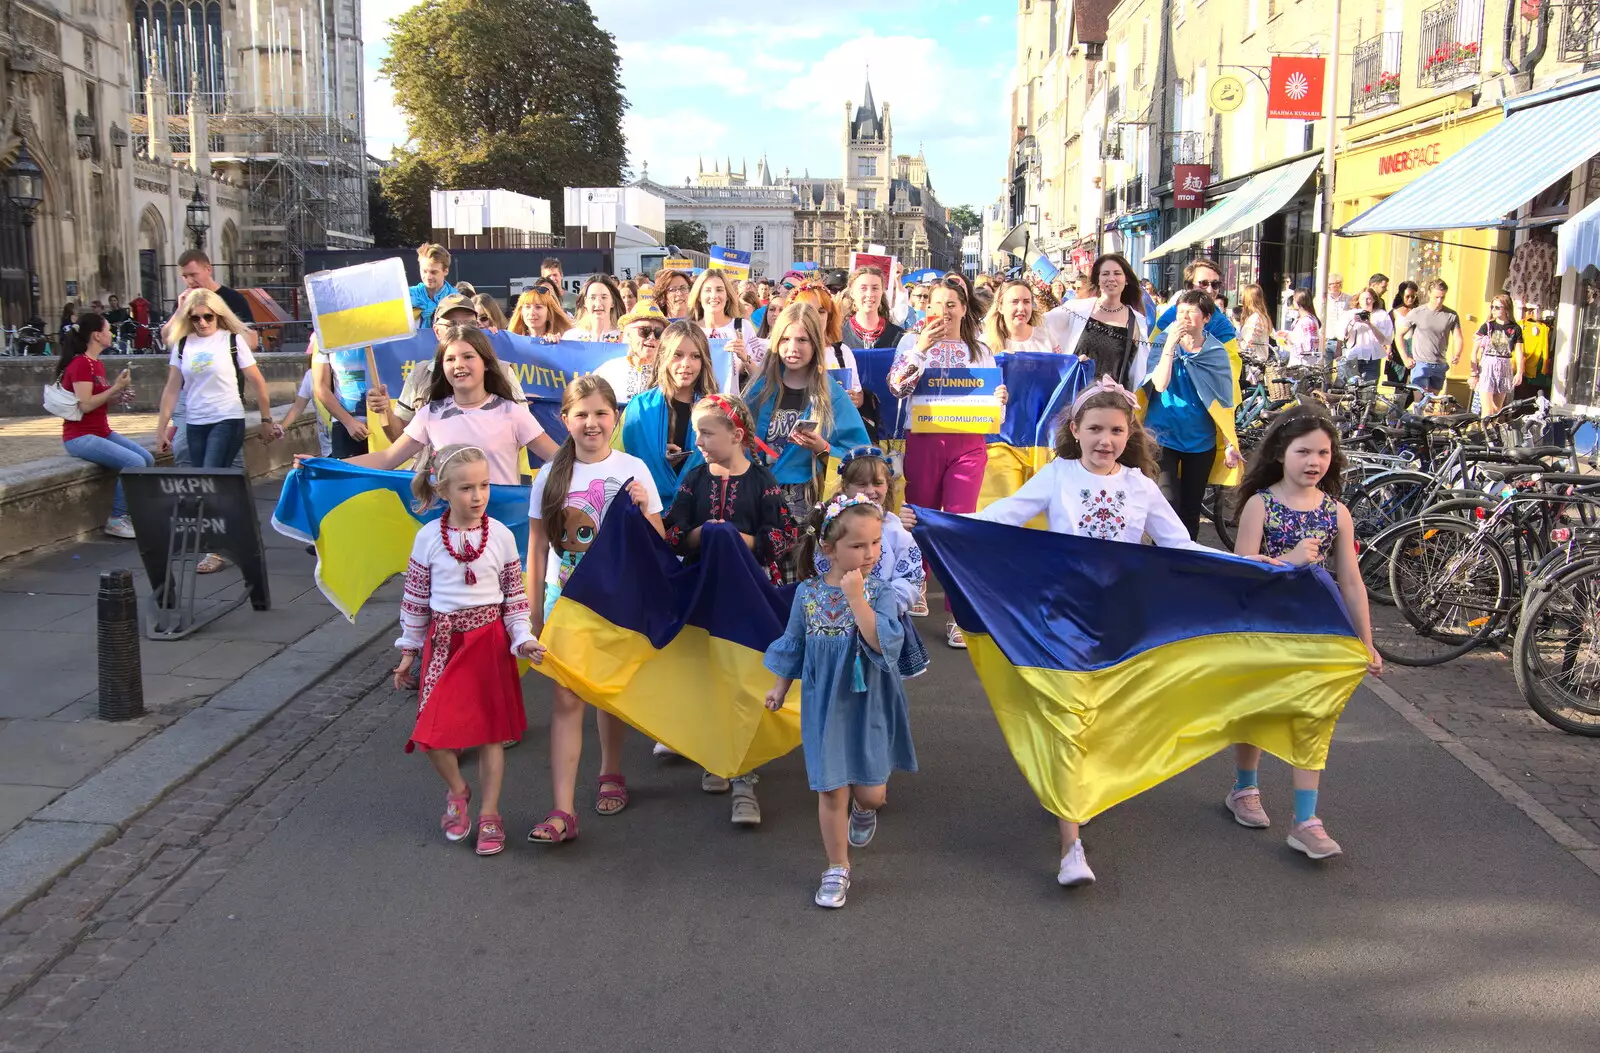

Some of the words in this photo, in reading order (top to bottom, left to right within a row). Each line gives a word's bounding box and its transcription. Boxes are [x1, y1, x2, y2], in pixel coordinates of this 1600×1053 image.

[1378, 143, 1441, 175] INNERSPACE
[511, 363, 567, 388] WITH
[927, 378, 985, 388] STUNNING
[917, 415, 994, 423] ПРИГОЛОМШЛИВА
[160, 478, 216, 494] UKPN
